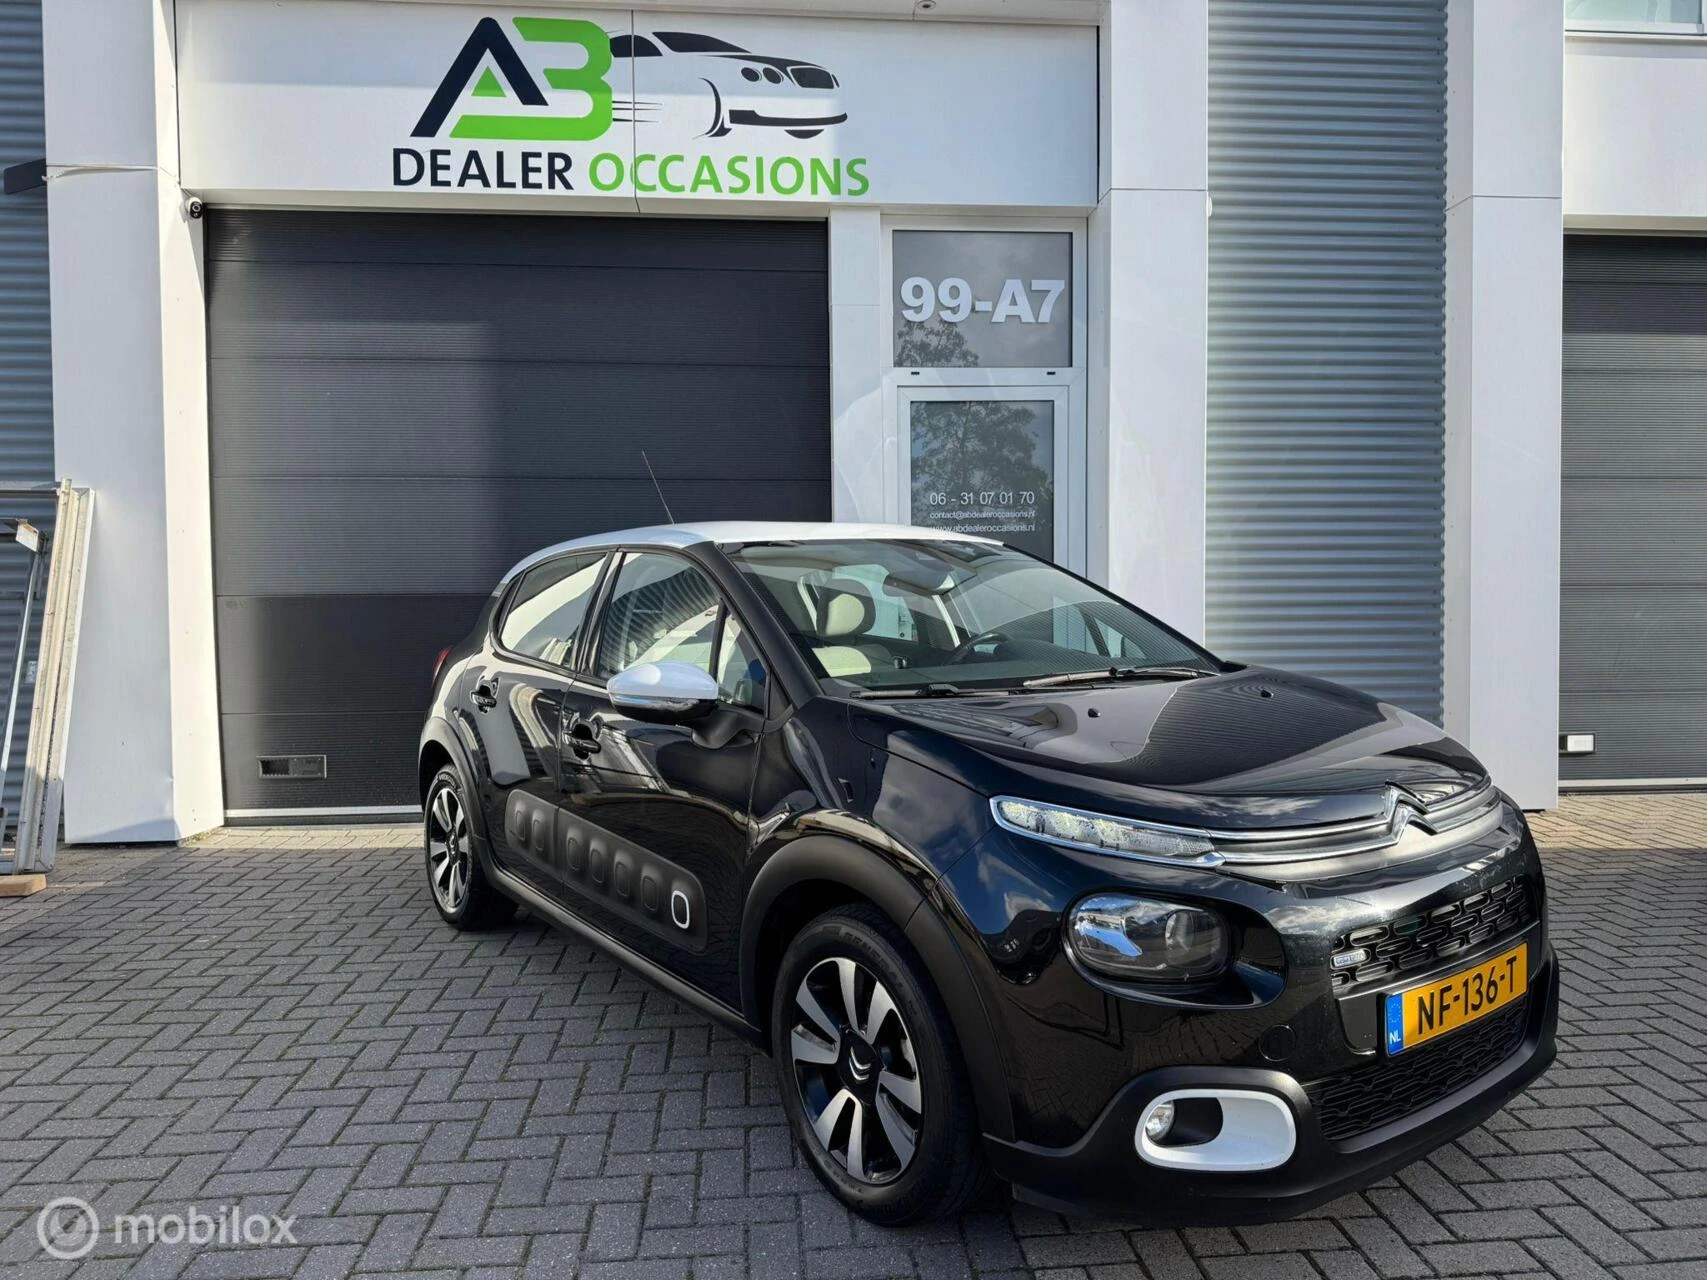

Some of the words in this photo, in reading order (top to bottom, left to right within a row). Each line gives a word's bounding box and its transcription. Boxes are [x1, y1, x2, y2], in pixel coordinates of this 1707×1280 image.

[393, 148, 574, 190] DEALER
[589, 152, 869, 196] OCCASIONS
[900, 277, 1065, 323] 99-A7
[930, 492, 946, 505] 06
[960, 492, 974, 505] 31
[980, 492, 995, 505] 07
[1000, 492, 1013, 504] 01
[1019, 491, 1035, 504] 70
[930, 510, 1035, 520] contact@abdealeroccasions.nl
[1418, 956, 1517, 1035] NF-136-T
[1389, 1030, 1401, 1044] NL
